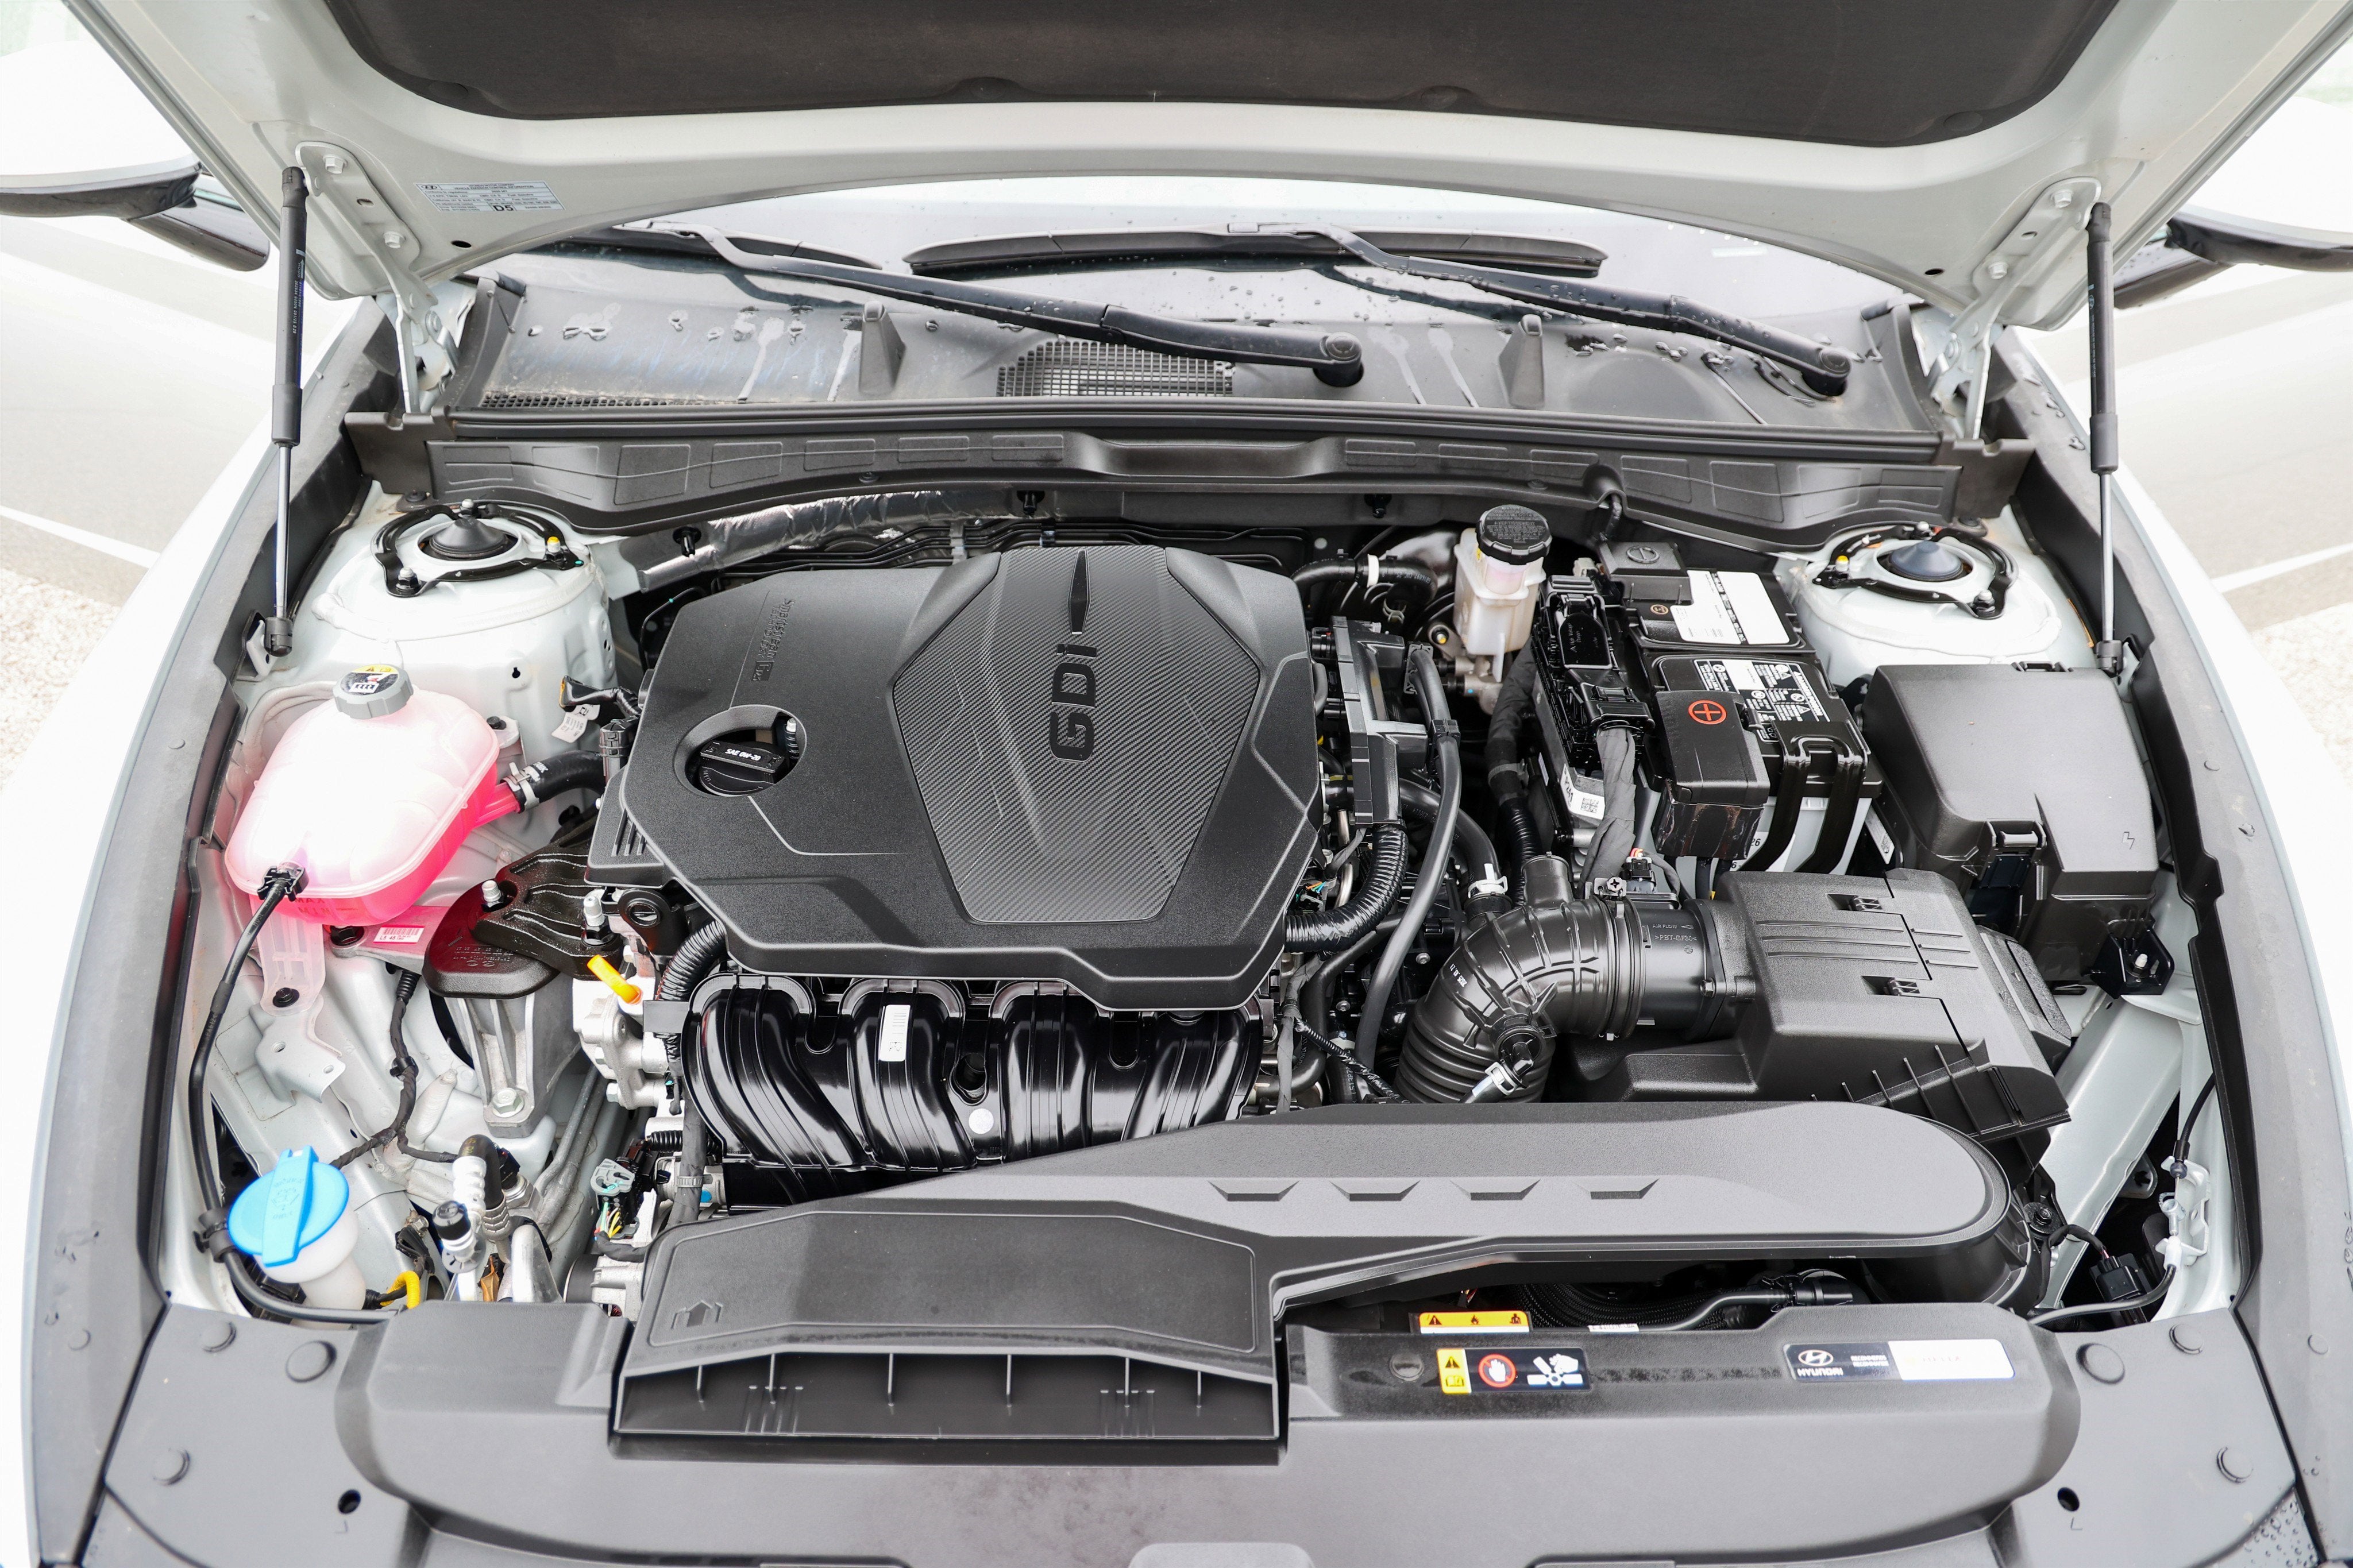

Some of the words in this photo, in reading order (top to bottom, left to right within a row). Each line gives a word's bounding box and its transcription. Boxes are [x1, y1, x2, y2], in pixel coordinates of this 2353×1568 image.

[725, 748, 739, 756] SAE
[739, 751, 761, 761] 0W-20
[1797, 1367, 1844, 1377] HYUNDAI
